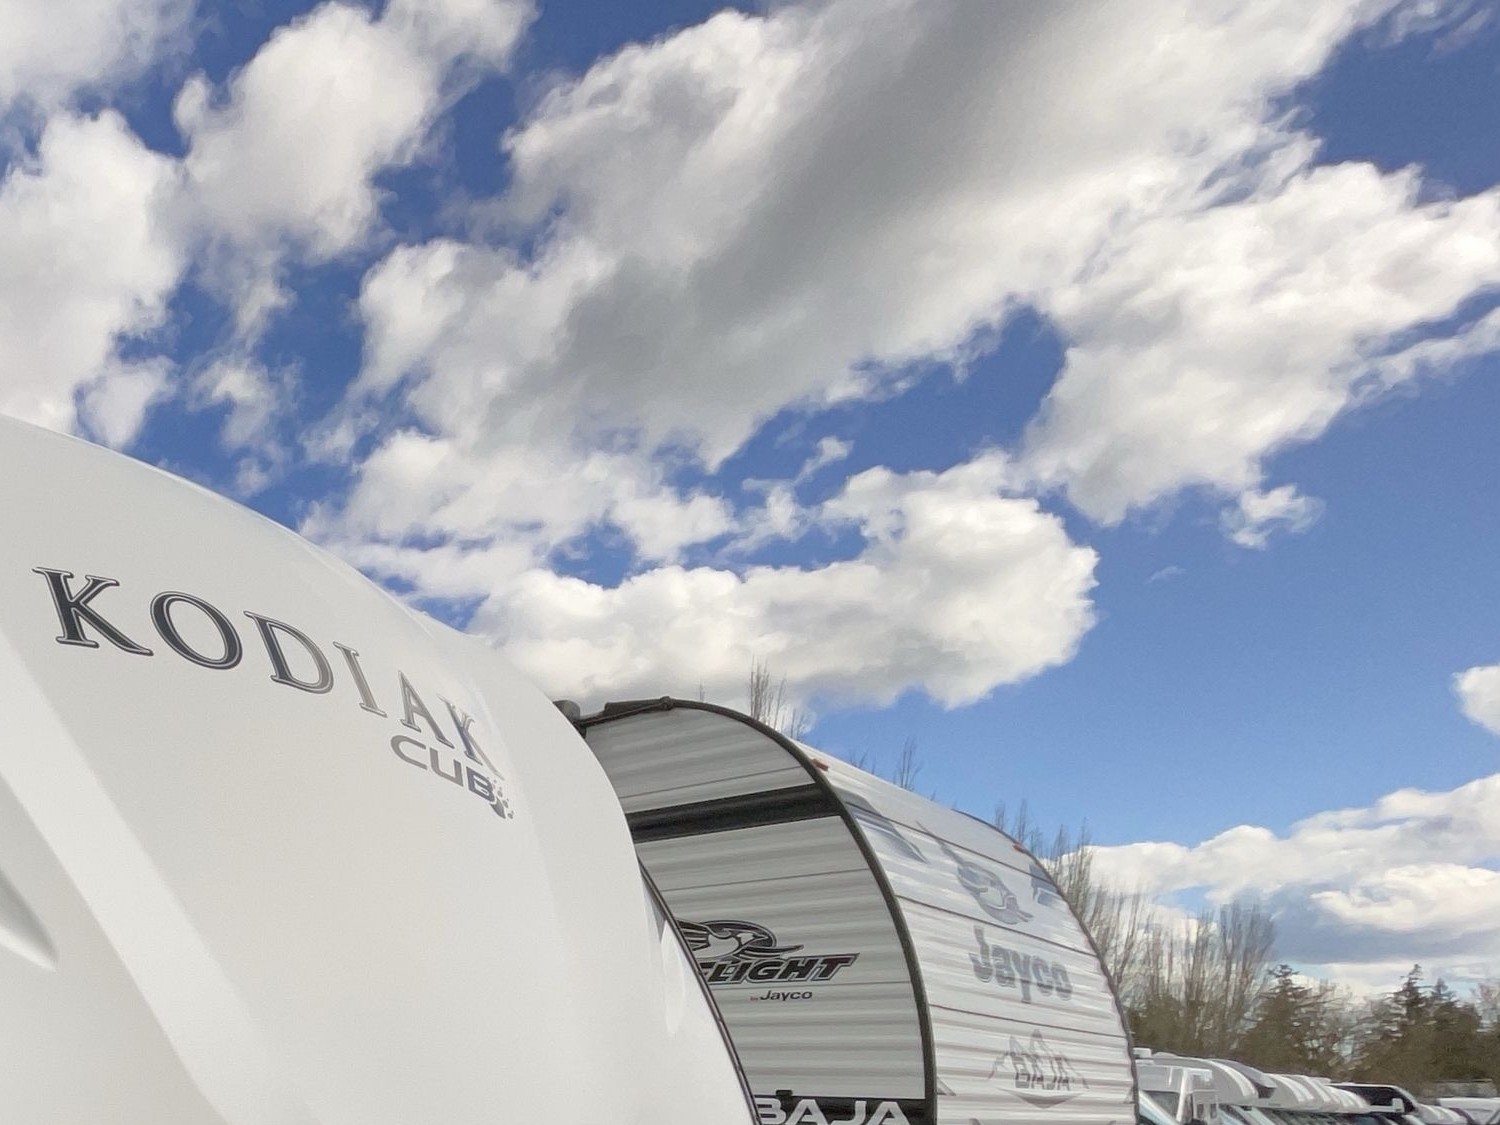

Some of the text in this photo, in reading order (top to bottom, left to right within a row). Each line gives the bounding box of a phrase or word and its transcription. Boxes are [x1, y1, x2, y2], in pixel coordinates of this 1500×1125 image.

[32, 566, 505, 781] KODIAK
[390, 734, 496, 803] CUB
[760, 989, 813, 1001] Jayco
[968, 924, 1074, 1005] Jayco
